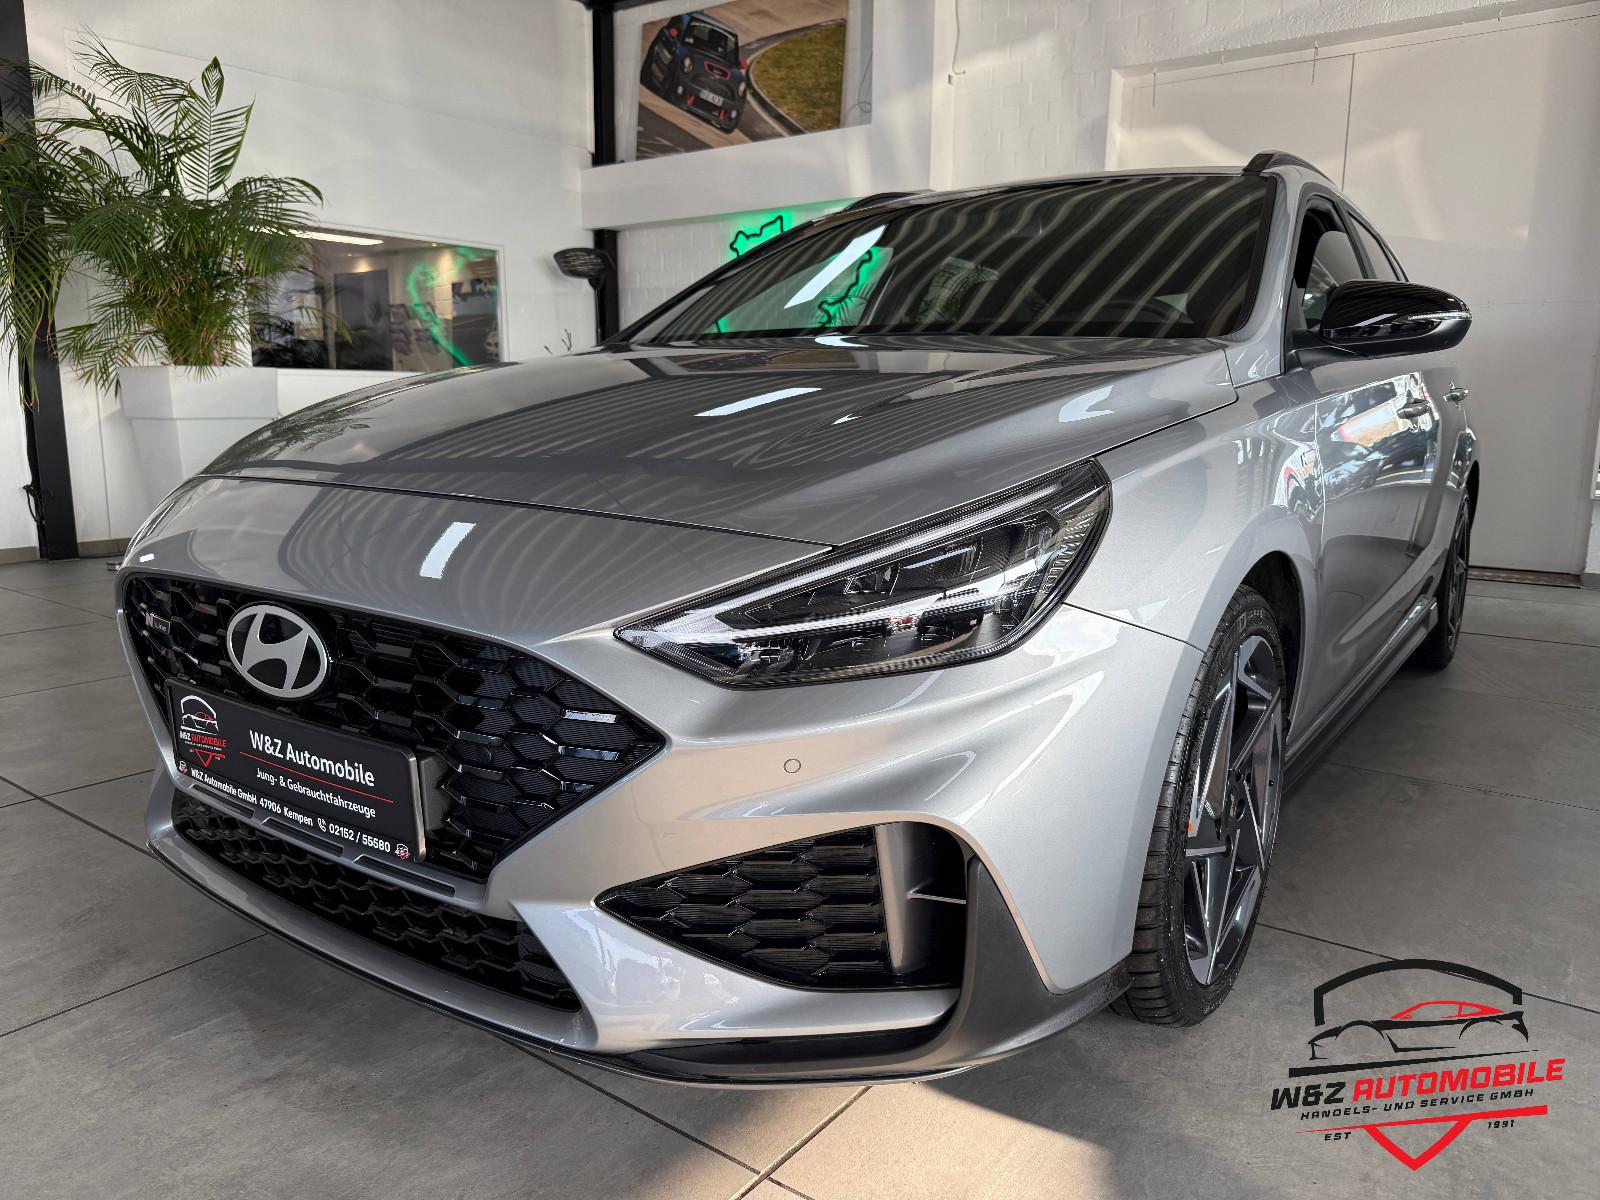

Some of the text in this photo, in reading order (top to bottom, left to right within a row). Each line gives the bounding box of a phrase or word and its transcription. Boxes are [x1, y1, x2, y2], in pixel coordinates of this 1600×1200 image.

[191, 732, 228, 748] AUTOMOBILE
[249, 729, 375, 787] W&Z Automobile
[190, 767, 391, 852] W&Z Automobile GmbH 47906 Kempen 02152 / 55580
[256, 767, 376, 818] Jung- & Gebrauchtfahrzeuge
